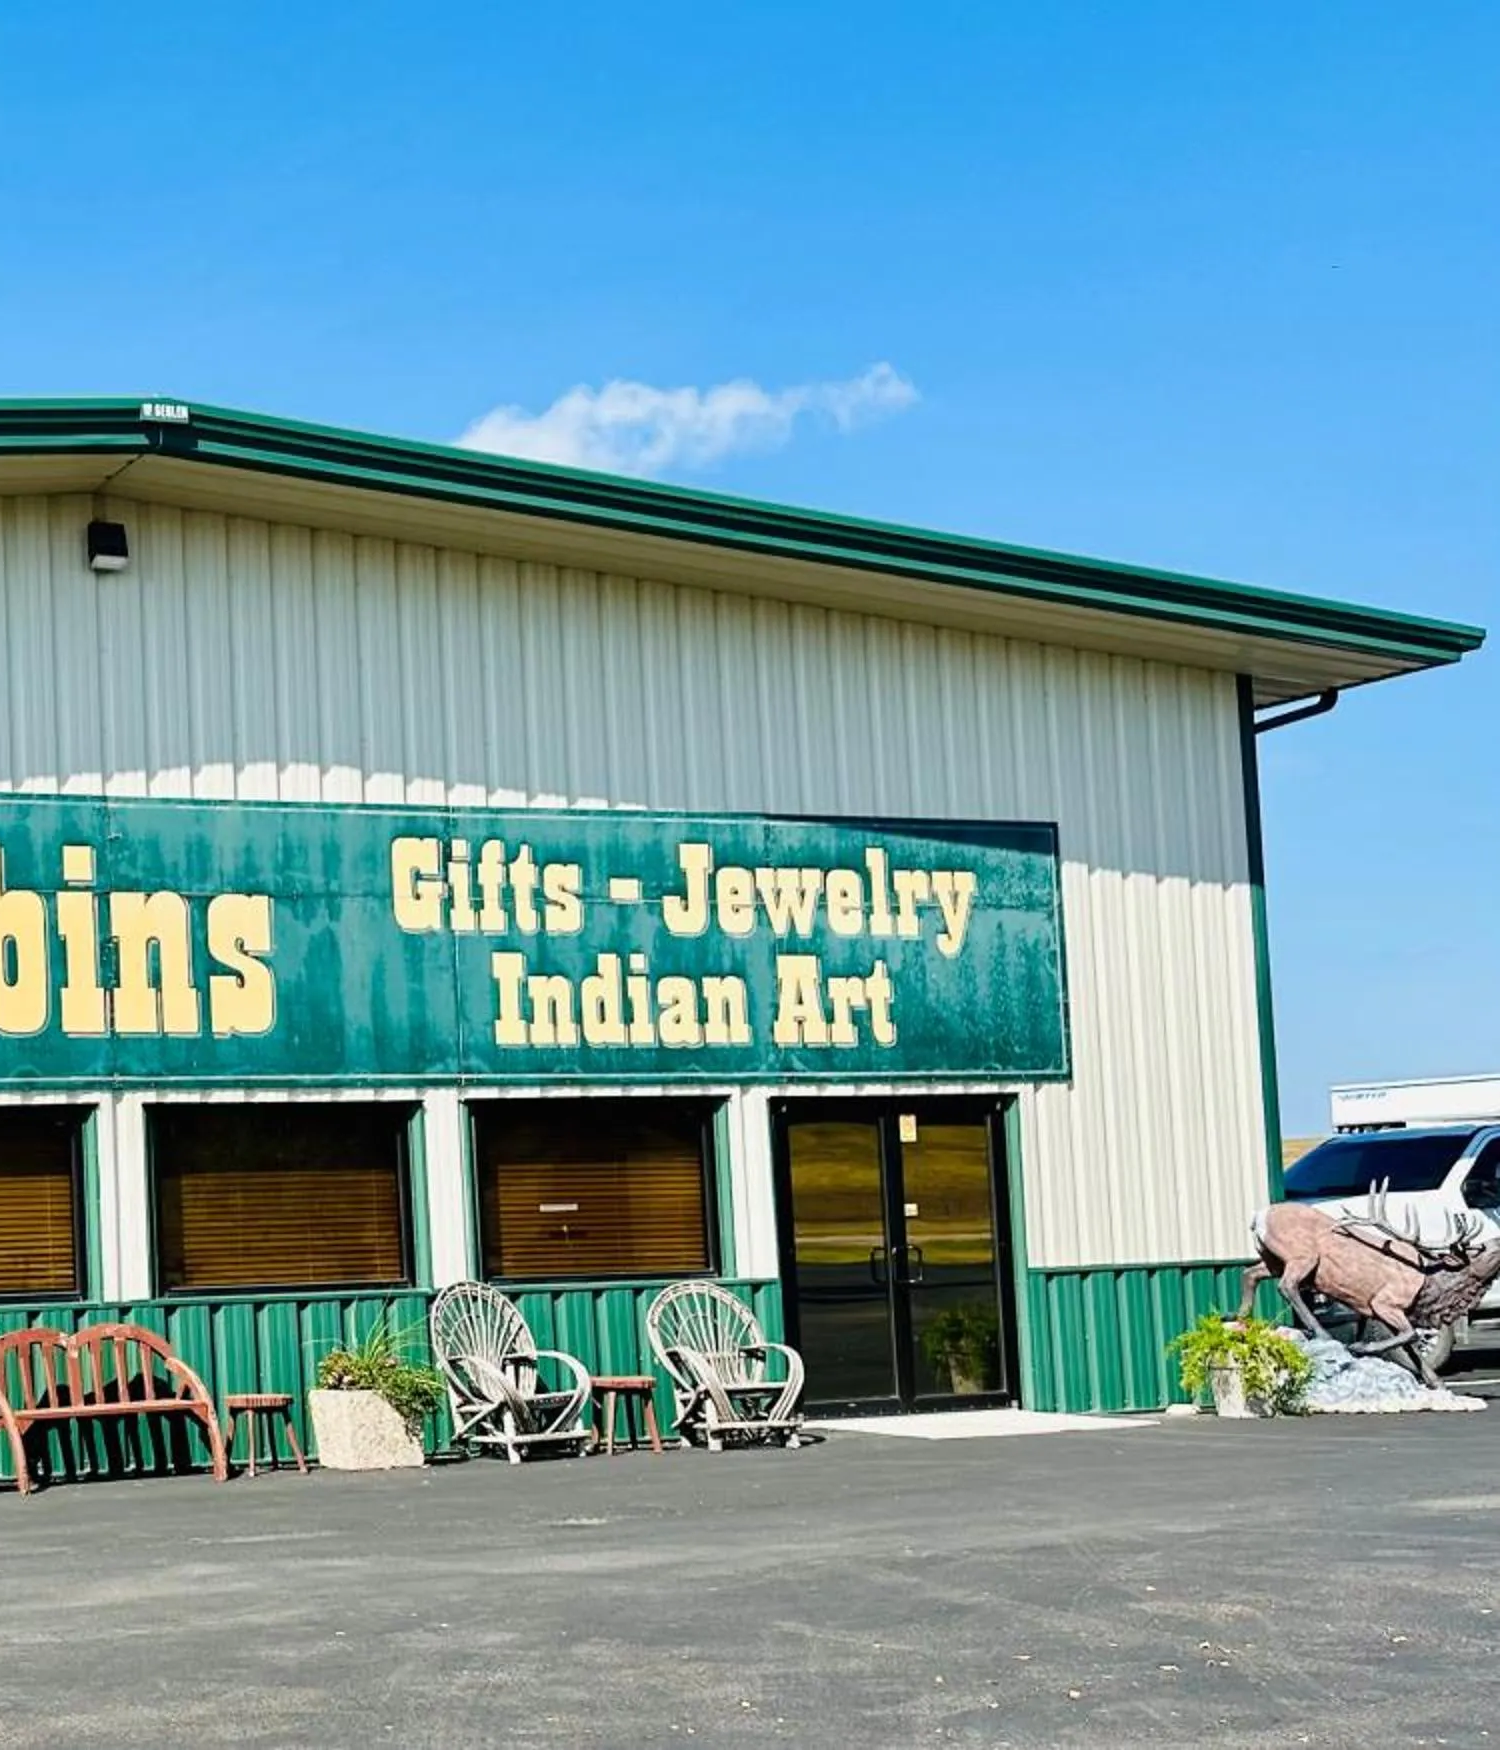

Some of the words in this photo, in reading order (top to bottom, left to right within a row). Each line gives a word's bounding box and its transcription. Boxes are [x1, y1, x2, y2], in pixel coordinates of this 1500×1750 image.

[391, 837, 585, 934] Gifts
[609, 878, 642, 904] -
[662, 843, 978, 959] Jewelry
[491, 951, 753, 1048] Indian
[774, 954, 897, 1048] Art
